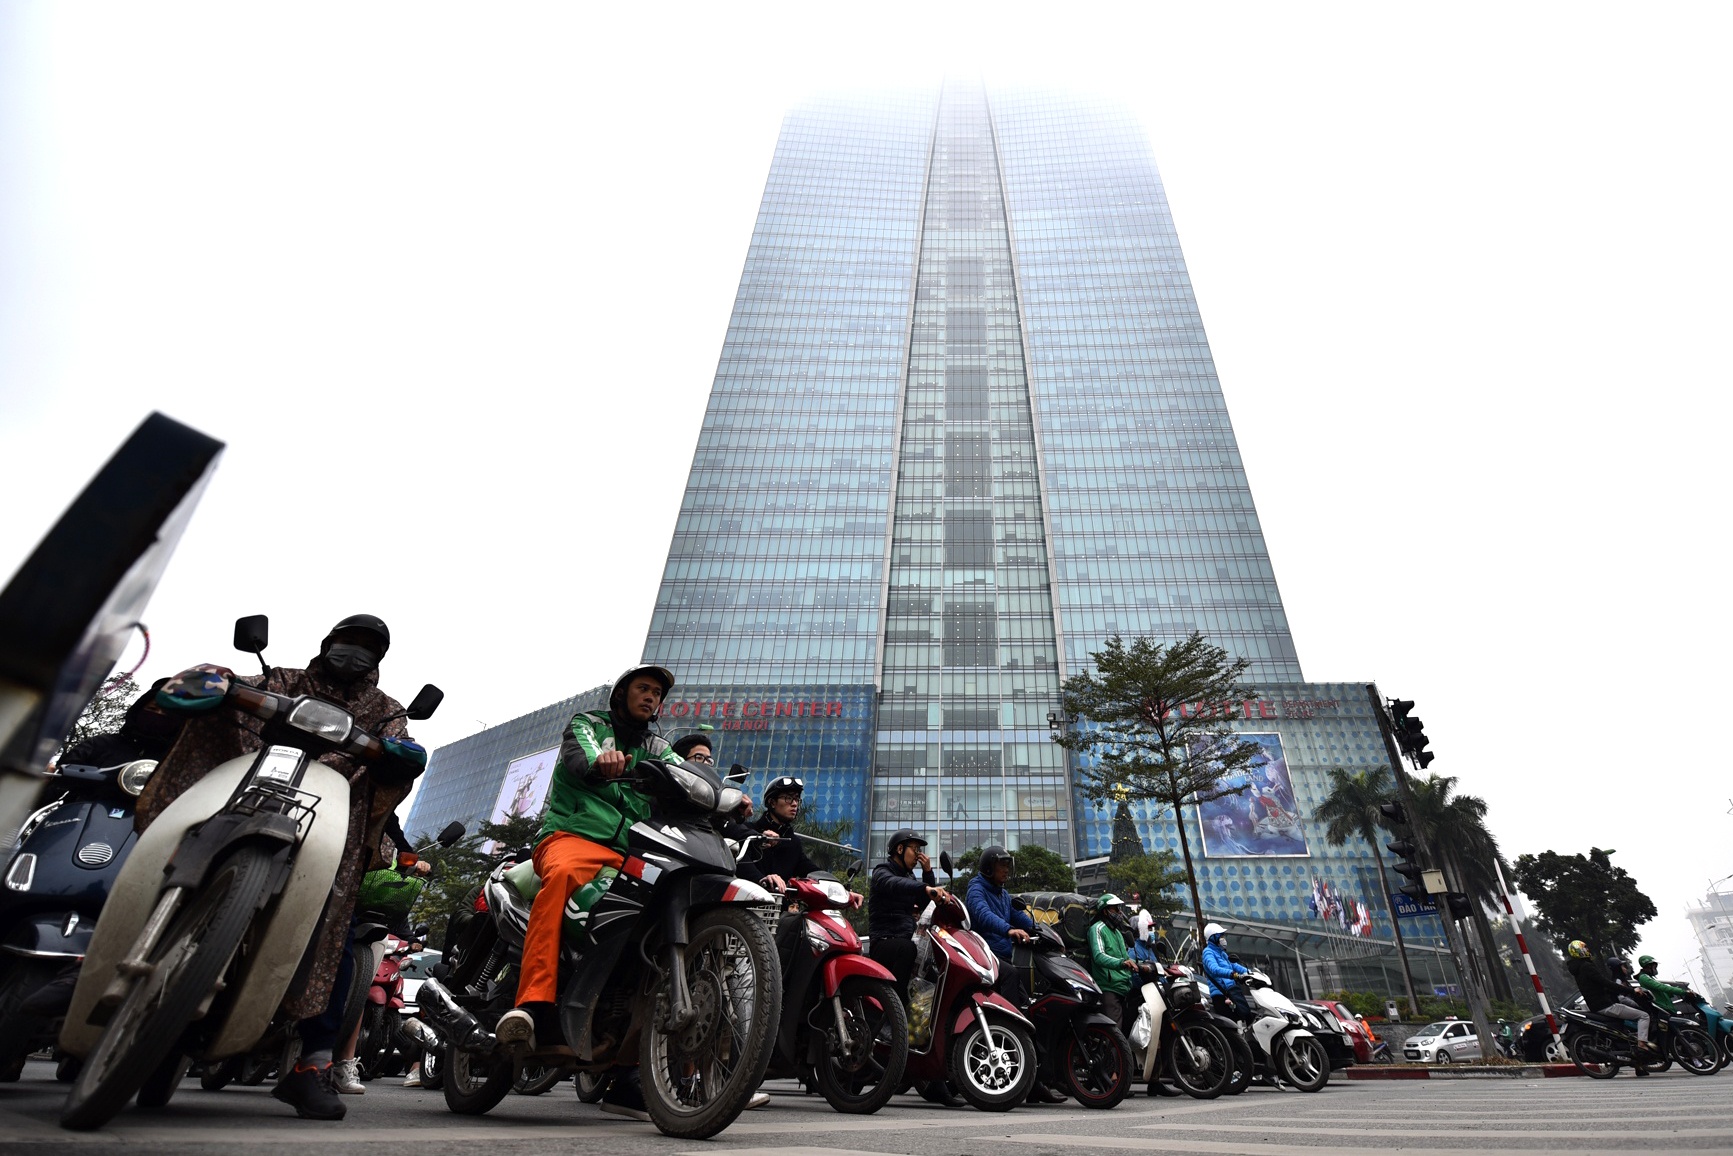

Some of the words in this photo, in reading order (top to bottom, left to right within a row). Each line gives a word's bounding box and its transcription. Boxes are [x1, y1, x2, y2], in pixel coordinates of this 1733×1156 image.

[658, 701, 735, 717] LOTTE
[742, 701, 842, 717] CENTER
[722, 720, 768, 730] HANOI
